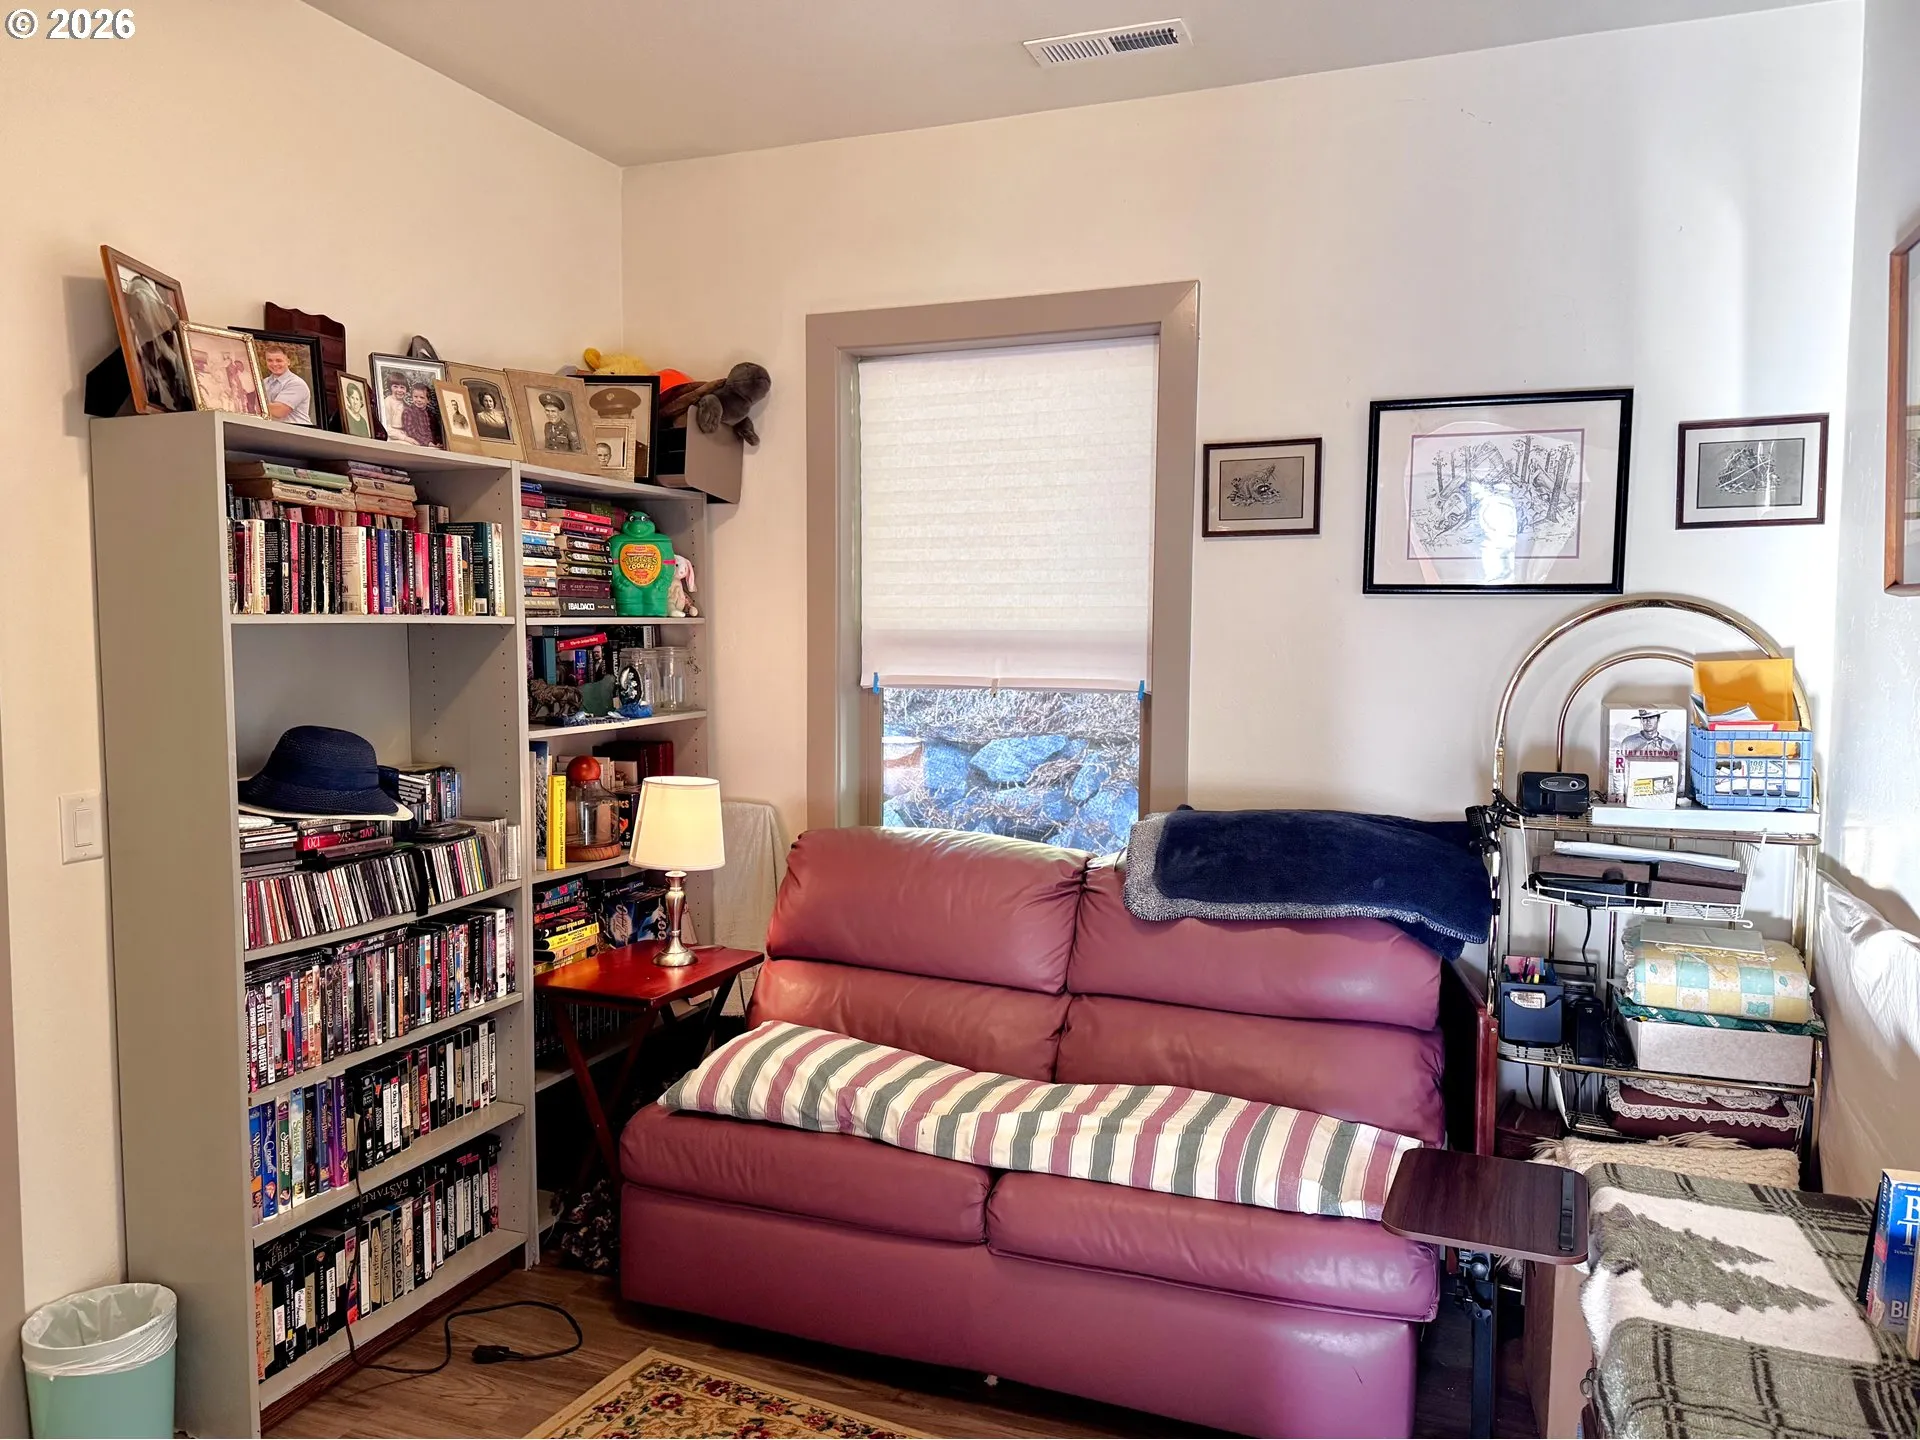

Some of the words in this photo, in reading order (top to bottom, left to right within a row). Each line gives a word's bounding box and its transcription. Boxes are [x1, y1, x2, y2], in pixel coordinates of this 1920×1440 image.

[628, 562, 654, 571] COOKIES
[307, 836, 321, 848] 120
[359, 827, 376, 839] JVC
[257, 1003, 265, 1026] STEVE
[258, 1037, 266, 1073] McQUEEN
[292, 1120, 303, 1159] SHREK
[391, 1117, 399, 1138] nights
[252, 1132, 260, 1160] Wizard
[264, 1140, 275, 1174] Cinderella
[1879, 1176, 1888, 1204] BRAD
[1879, 1205, 1887, 1231] THOR
[264, 1237, 301, 1271] REBELS
